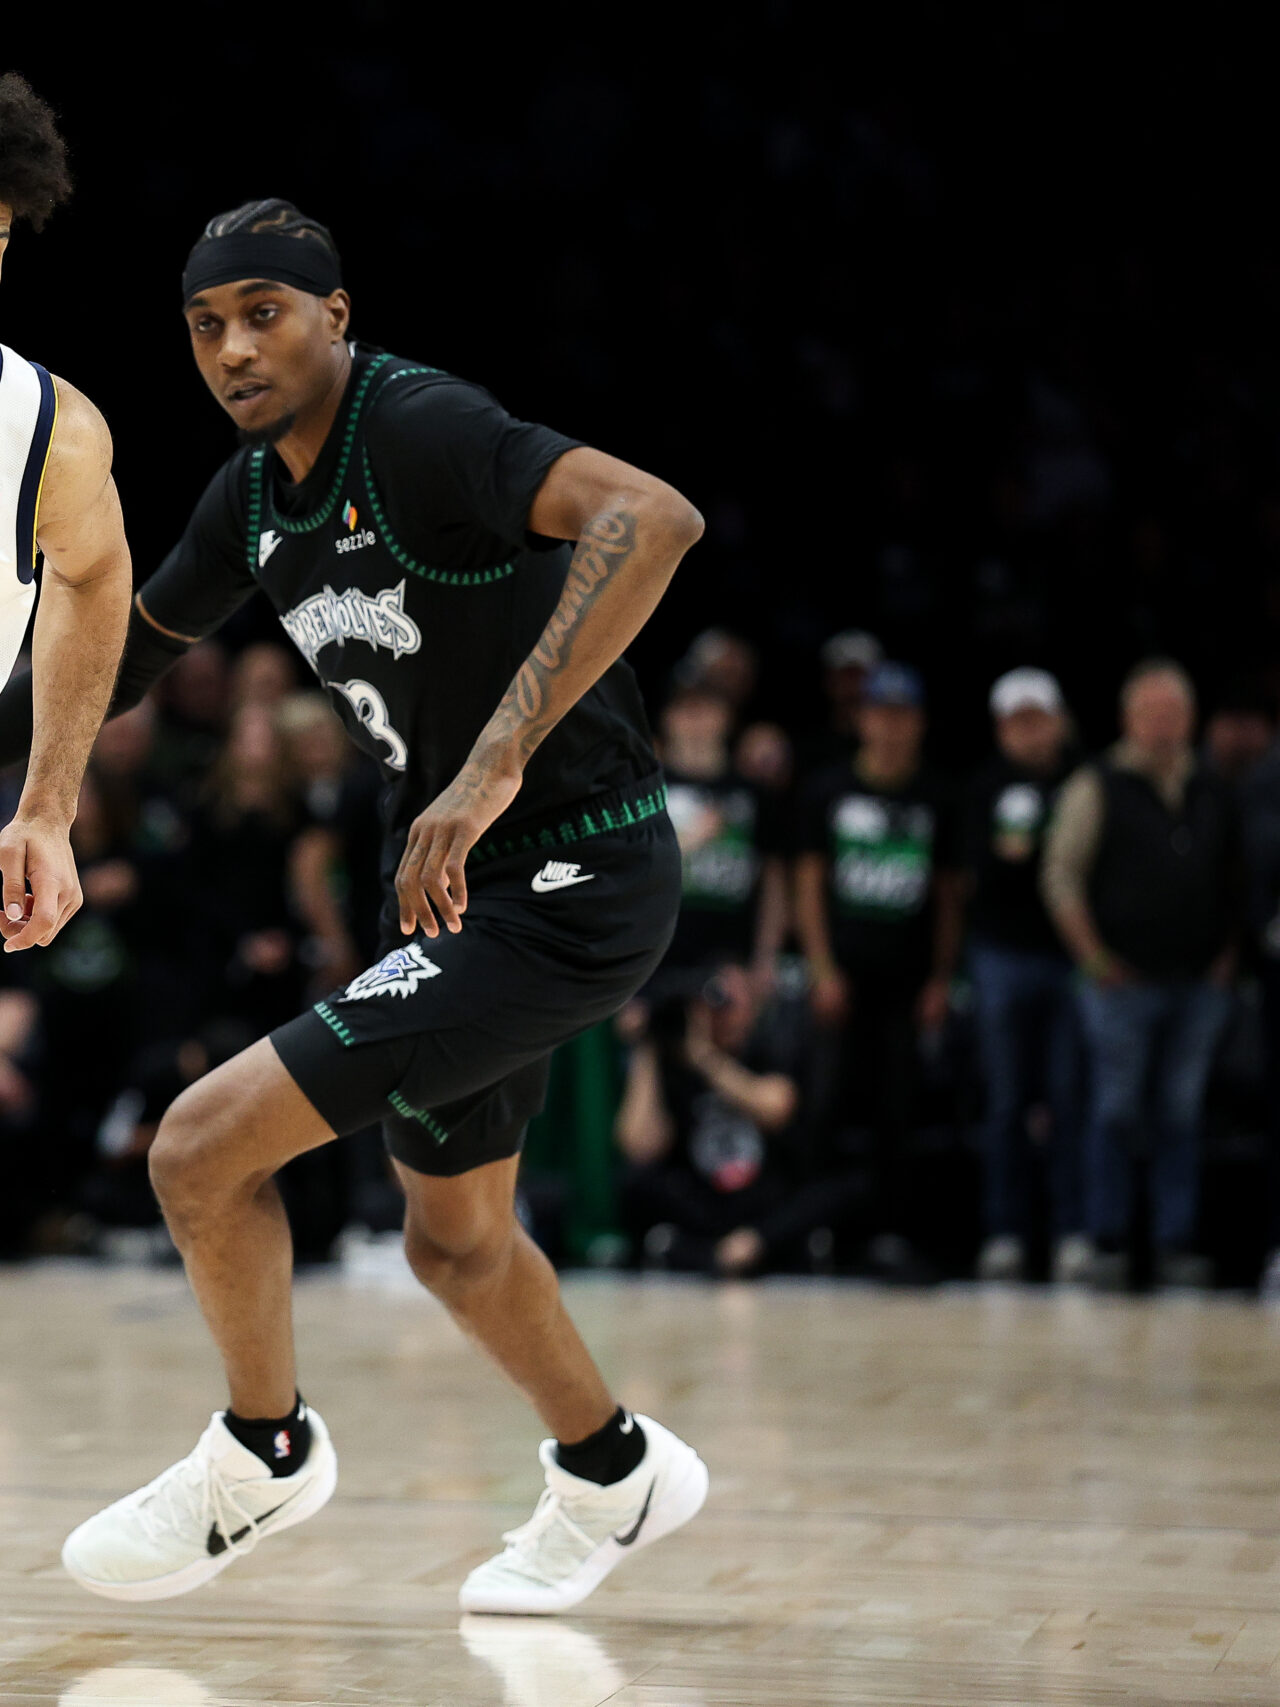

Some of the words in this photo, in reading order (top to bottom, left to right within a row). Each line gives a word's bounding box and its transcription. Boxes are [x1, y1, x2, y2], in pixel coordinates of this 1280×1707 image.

[335, 528, 376, 554] sezzle
[327, 678, 408, 772] 3
[541, 859, 582, 882] NIKE
